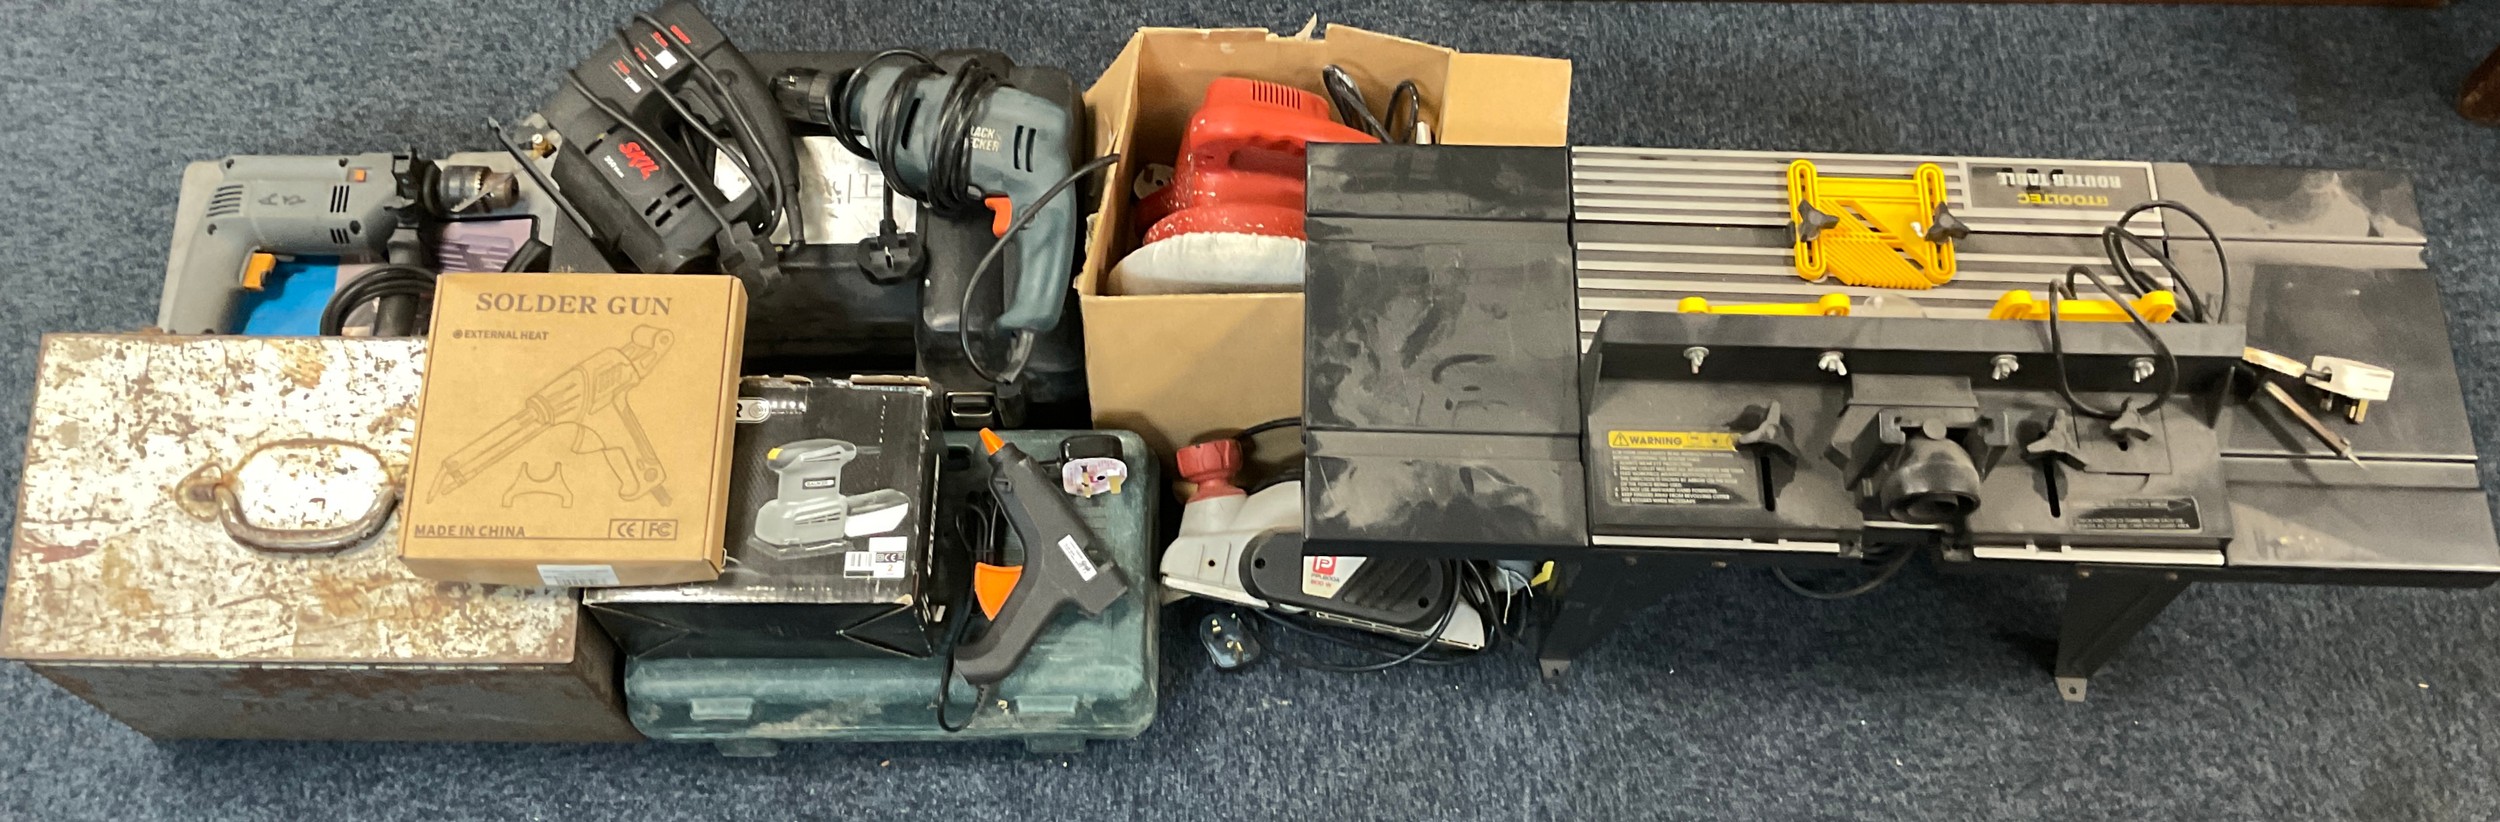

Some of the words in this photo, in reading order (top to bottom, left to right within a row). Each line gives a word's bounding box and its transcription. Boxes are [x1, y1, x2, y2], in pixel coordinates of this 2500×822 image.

[970, 125, 996, 139] LACK
[618, 141, 660, 180] SKIL
[1997, 172, 2050, 186] TABLE
[2052, 173, 2121, 188] ROUTER
[476, 292, 597, 314] SOLDER
[607, 296, 673, 315] GUN
[464, 329, 518, 340] EXTERNAL
[520, 331, 549, 340] HEAT
[1629, 436, 1682, 446] WARNING
[414, 525, 456, 536] MADE
[460, 525, 475, 536] IN
[479, 525, 526, 537] CHINA
[617, 522, 636, 537] CE
[884, 553, 897, 562] CE
